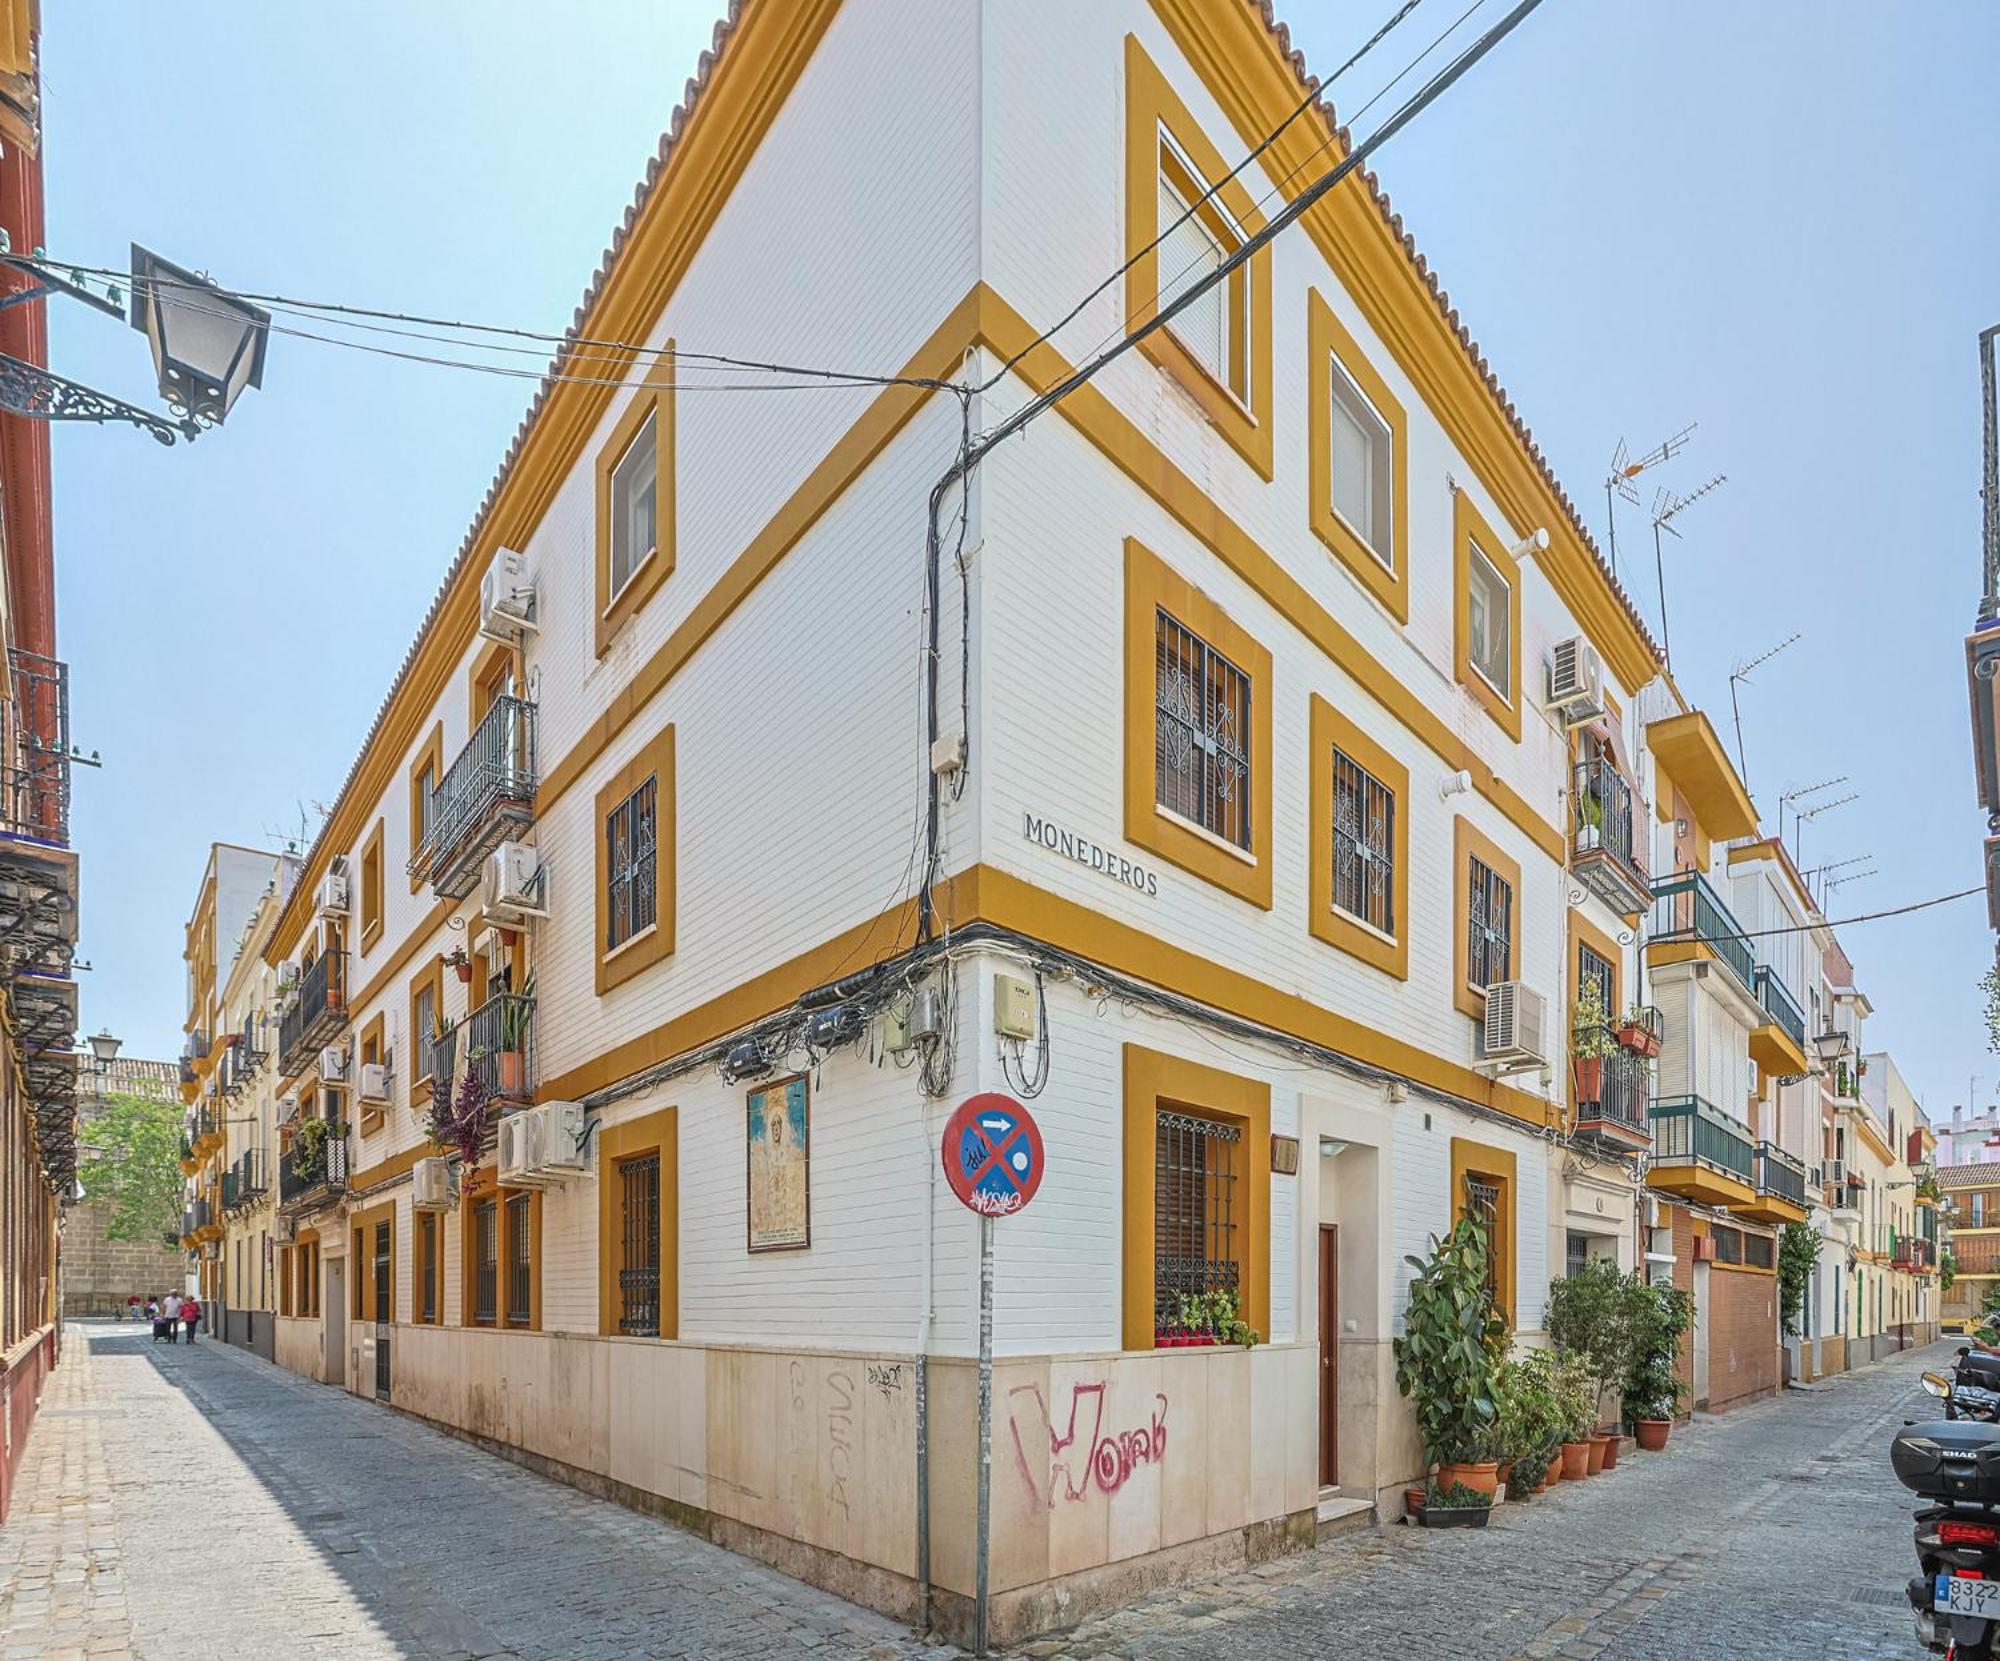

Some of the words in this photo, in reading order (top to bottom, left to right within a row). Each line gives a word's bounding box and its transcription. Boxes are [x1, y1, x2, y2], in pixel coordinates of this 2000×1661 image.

[1025, 813, 1157, 896] MONEDEROS
[1942, 1451, 1977, 1459] SHAD
[1951, 1580, 1999, 1600] 8322
[1950, 1595, 1985, 1613] KJY
